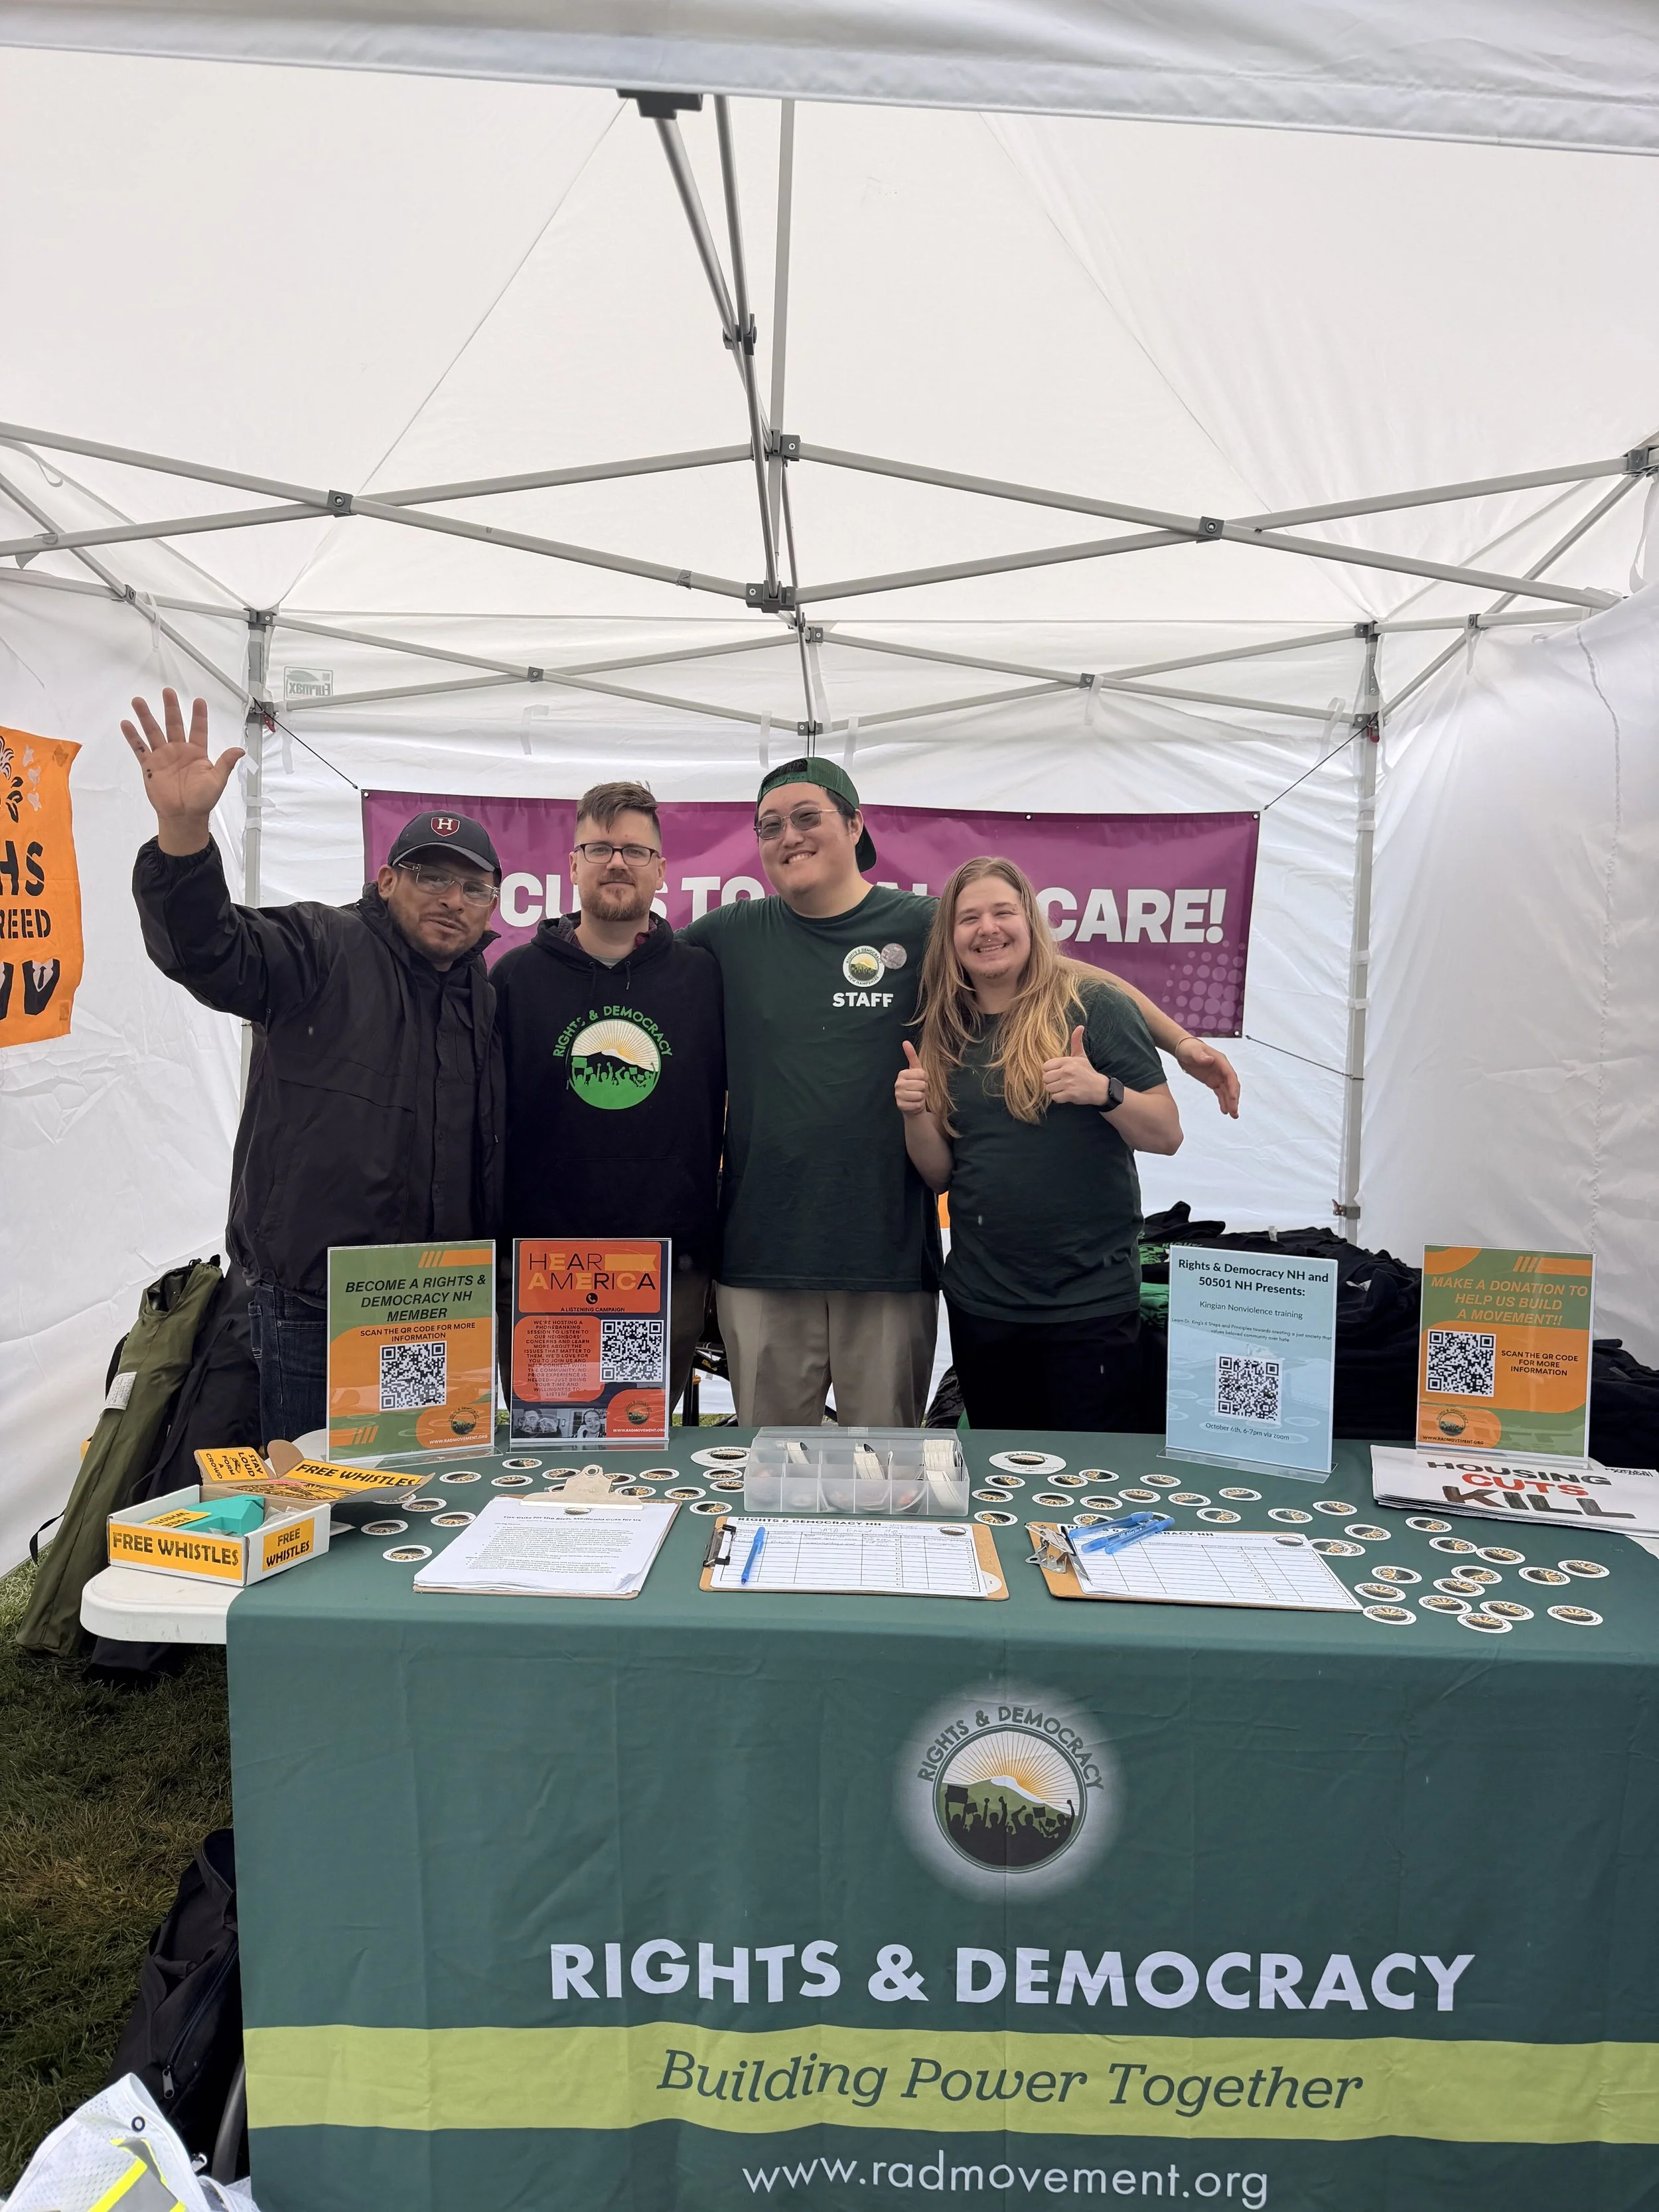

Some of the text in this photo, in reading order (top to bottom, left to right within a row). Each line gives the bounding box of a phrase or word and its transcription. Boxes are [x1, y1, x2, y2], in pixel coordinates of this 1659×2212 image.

[437, 819, 453, 830] H
[1036, 887, 1226, 944] CARE!
[833, 992, 893, 1007] STAFF
[553, 1005, 673, 1057] RIGHTS & DEMOCRACY
[530, 1253, 603, 1270] HEAR
[1179, 1259, 1329, 1282] Rights & Democracy NH and
[346, 1275, 486, 1292] BECOME A RIGHTS &
[528, 1272, 656, 1290] AMERICA
[1199, 1277, 1305, 1296] 50501 NH Presents:
[1431, 1277, 1588, 1296] MAKE A DONATION TO
[361, 1291, 472, 1307] DEMOCRACY NH
[1455, 1293, 1562, 1310] HELP US BUILD
[387, 1308, 447, 1321] MEMBER
[1200, 1301, 1303, 1319] Kingian Nonviolence training
[1457, 1309, 1562, 1325] A MOVEMENT!!
[392, 1333, 446, 1342] INFORMATION
[1511, 1366, 1567, 1376] INFORMATION
[429, 1434, 488, 1444] WWW.RADMOVEMENT.ORG
[1423, 1436, 1483, 1445] WWW.RADMOVEMENT.ORG
[206, 1453, 222, 1479] CROWD
[222, 1455, 235, 1475] FORM
[238, 1452, 255, 1477] LOUD
[249, 1454, 263, 1474] STAY
[1427, 1461, 1613, 1486] HOUSING
[295, 1464, 415, 1487] FREE WHISTLES
[1461, 1473, 1589, 1496] CUTS
[1442, 1486, 1637, 1519] KILL
[277, 1528, 300, 1546] FREE
[113, 1532, 238, 1566] FREE WHISTLES
[266, 1540, 310, 1568] WHISTLES
[917, 1706, 1104, 1791] RIGHTS & DEMOCRACY
[550, 1938, 1475, 2012] RIGHTS & DEMOCRACY
[657, 2048, 1364, 2118] Building Power Together
[742, 2150, 1268, 2210] www.radmovement.org
